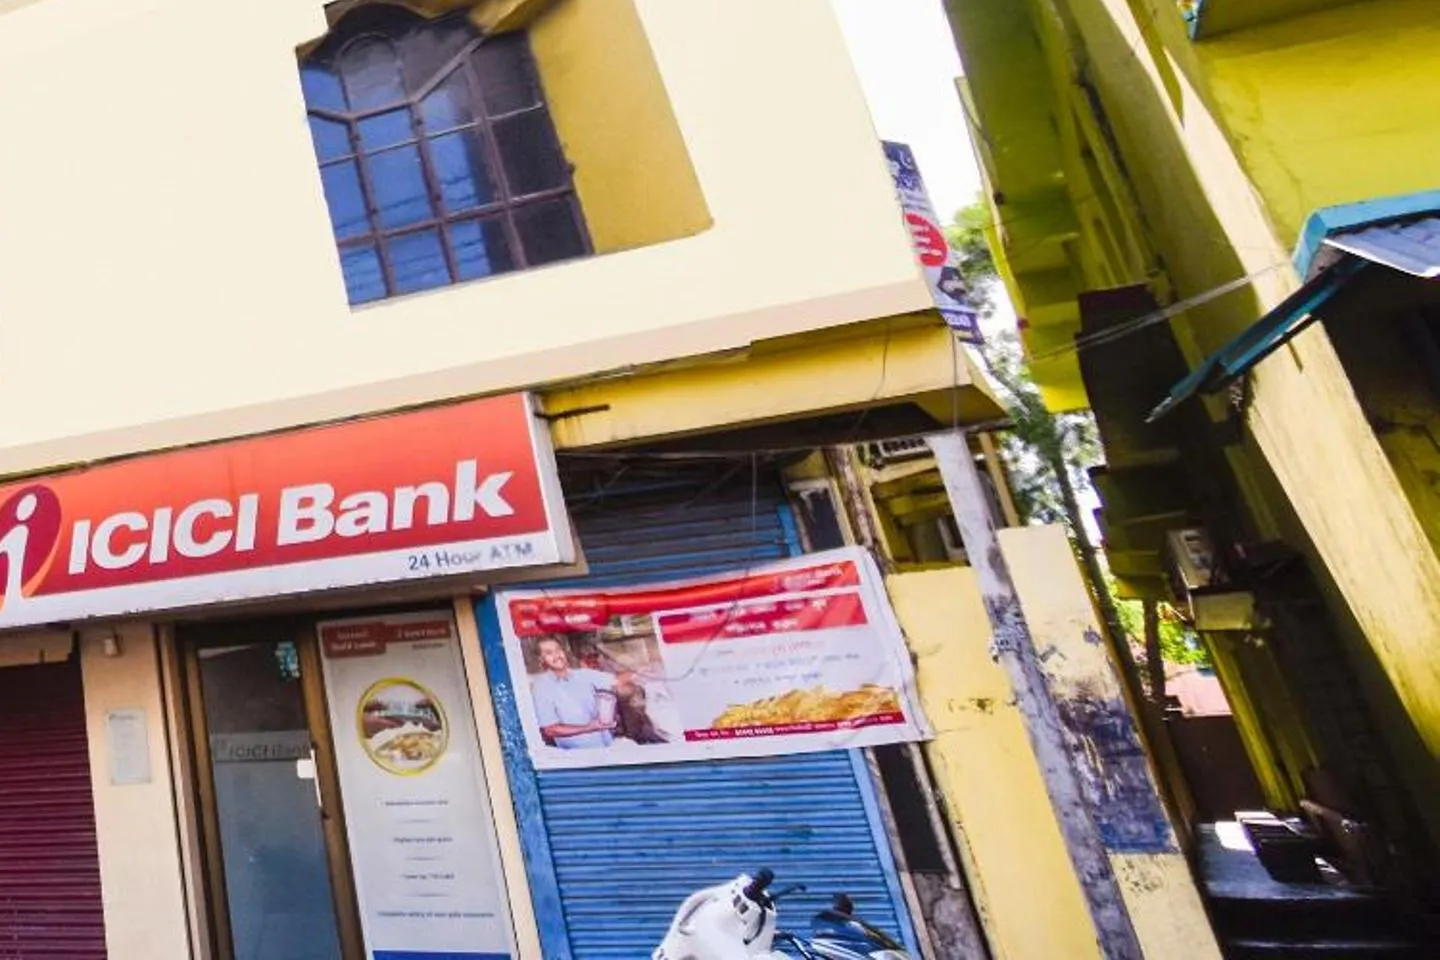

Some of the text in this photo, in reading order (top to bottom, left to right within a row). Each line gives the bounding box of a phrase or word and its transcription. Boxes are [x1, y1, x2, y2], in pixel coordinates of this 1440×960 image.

[68, 493, 259, 575] ICICI
[276, 458, 515, 547] Bank
[408, 553, 429, 571] 24
